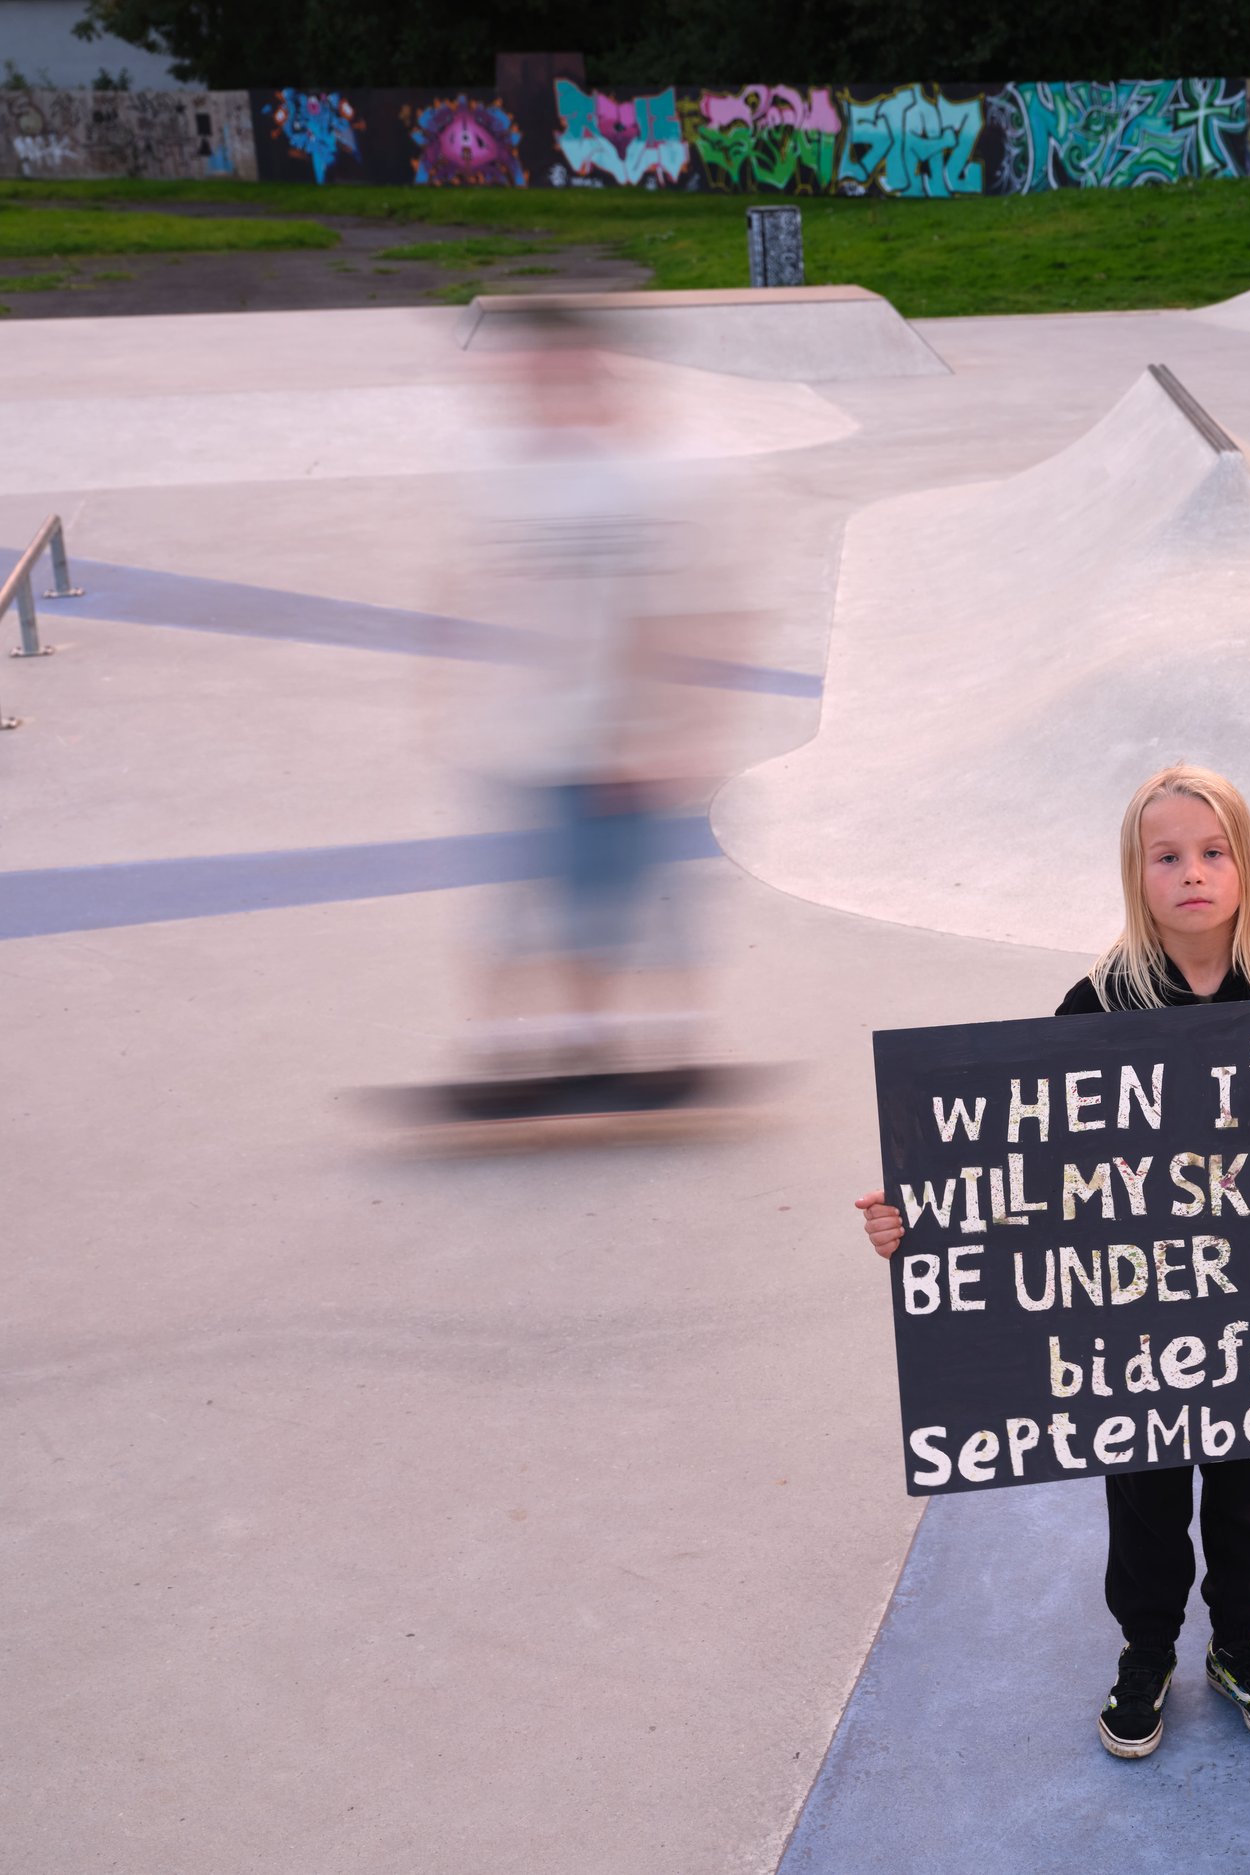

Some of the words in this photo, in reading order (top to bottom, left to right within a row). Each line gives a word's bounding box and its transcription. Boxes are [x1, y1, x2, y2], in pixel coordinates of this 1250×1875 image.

[933, 1063, 1164, 1143] WHEN
[900, 1153, 1048, 1234] WILL
[1063, 1156, 1153, 1220] MY
[903, 1245, 986, 1315] BE
[1014, 1235, 1238, 1311] UNDER
